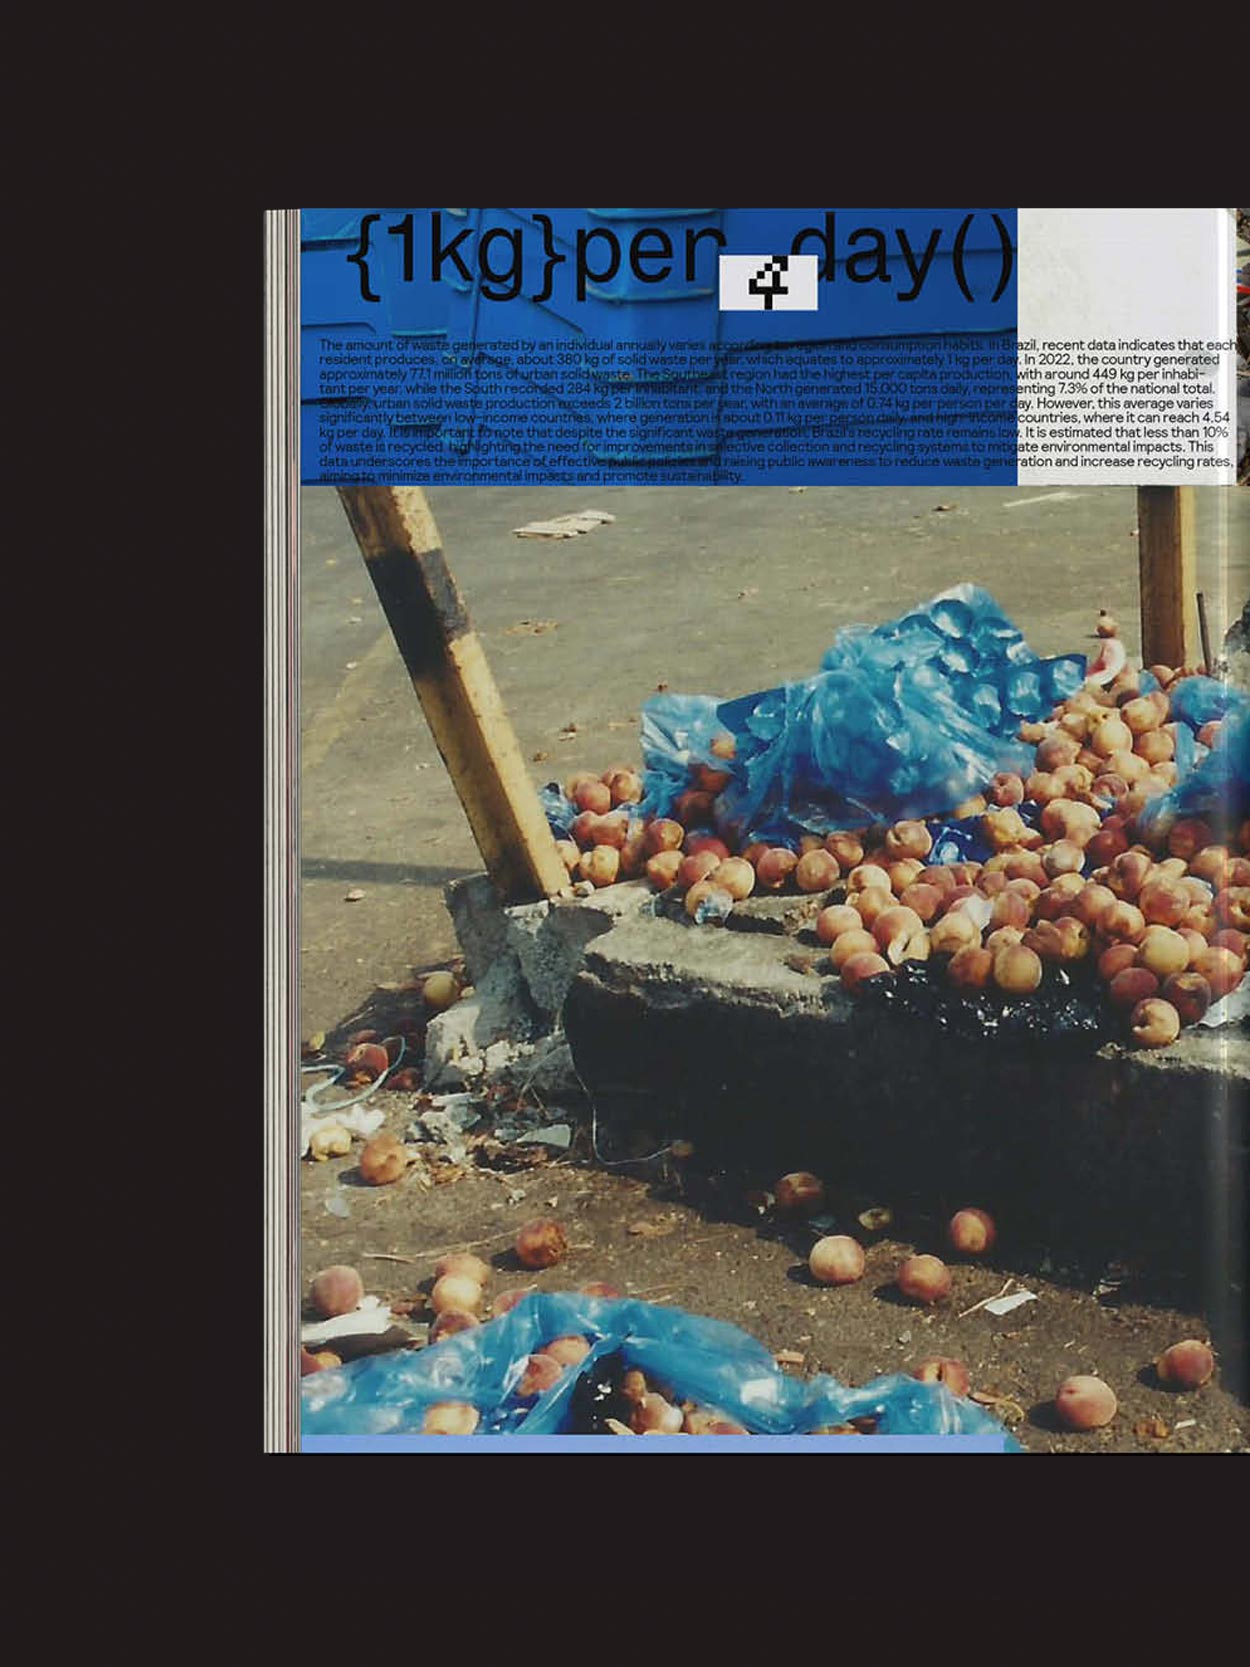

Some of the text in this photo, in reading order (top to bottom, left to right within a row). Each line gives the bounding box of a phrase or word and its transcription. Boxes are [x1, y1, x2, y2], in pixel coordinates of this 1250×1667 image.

[346, 211, 1014, 304] {1kg}per day()
[748, 255, 789, 309] 4
[1041, 339, 1085, 350] recent
[1087, 339, 1116, 350] data
[1118, 339, 1176, 350] indicates
[1177, 339, 1205, 350] that
[1206, 339, 1238, 350] each
[1024, 354, 1036, 365] In
[1038, 354, 1074, 366] 2022,
[1076, 354, 1099, 365] the
[1101, 354, 1152, 368] country
[1153, 354, 1220, 368] generated
[1016, 368, 1042, 380] with
[1044, 368, 1090, 380] around
[1092, 368, 1118, 380] 449
[1119, 368, 1135, 382] kg
[1137, 370, 1159, 382] per
[1161, 368, 1206, 380] inhabi-
[1058, 382, 1088, 394] 7.3%
[1089, 382, 1104, 394] of
[1105, 382, 1129, 394] the
[1130, 382, 1180, 394] national
[1182, 382, 1216, 394] total.
[1036, 397, 1096, 410] However,
[1097, 397, 1121, 408] this
[1123, 400, 1175, 412] average
[1176, 397, 1214, 408] varies
[1017, 412, 1082, 424] countries,
[1083, 412, 1125, 423] where
[1126, 412, 1136, 423] it
[1136, 414, 1161, 423] can
[1162, 412, 1200, 423] reach
[1201, 412, 1231, 423] 4.54
[1024, 426, 1035, 438] It
[1036, 426, 1047, 438] is
[1048, 426, 1113, 438] estimated
[1114, 426, 1142, 438] that
[1143, 426, 1169, 438] less
[1170, 426, 1200, 438] than
[1202, 426, 1230, 438] 10%
[1042, 440, 1131, 452] environmental
[1132, 440, 1186, 455] impacts.
[1187, 440, 1214, 452] This
[1054, 455, 1079, 466] and
[1080, 455, 1135, 466] increase
[1137, 455, 1195, 470] recycling
[1196, 455, 1234, 468] rates,
